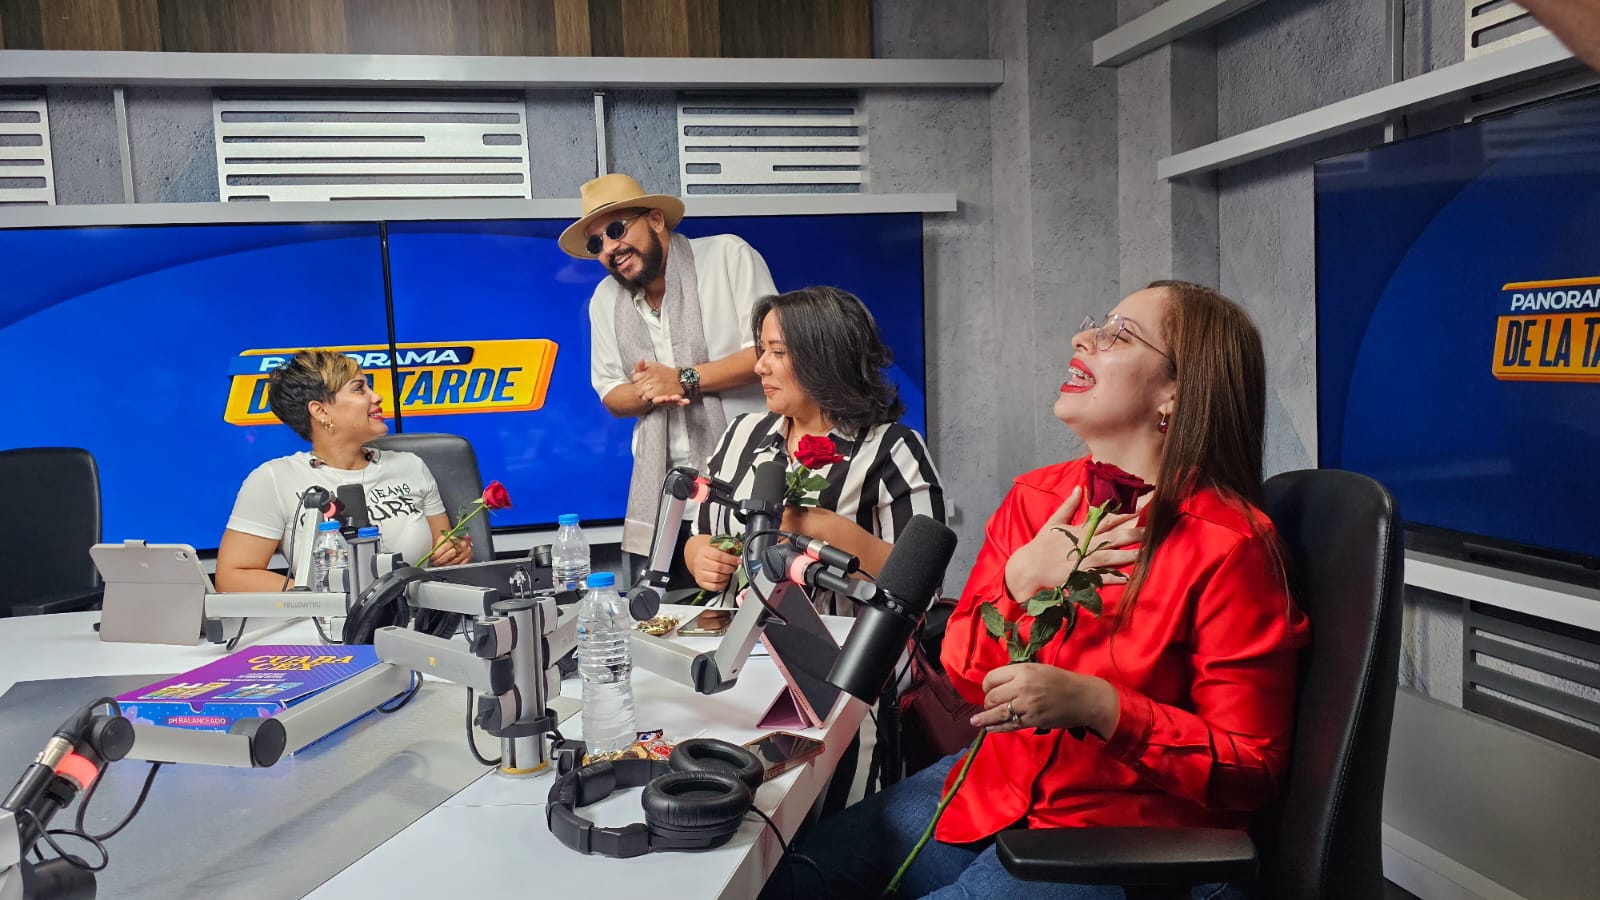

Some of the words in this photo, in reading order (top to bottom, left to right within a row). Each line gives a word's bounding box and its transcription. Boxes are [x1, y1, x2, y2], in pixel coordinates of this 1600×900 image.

[1510, 288, 1600, 311] PANORA
[1503, 319, 1537, 367] DE
[1539, 318, 1571, 367] LA
[178, 716, 226, 724] BALANCEADO
